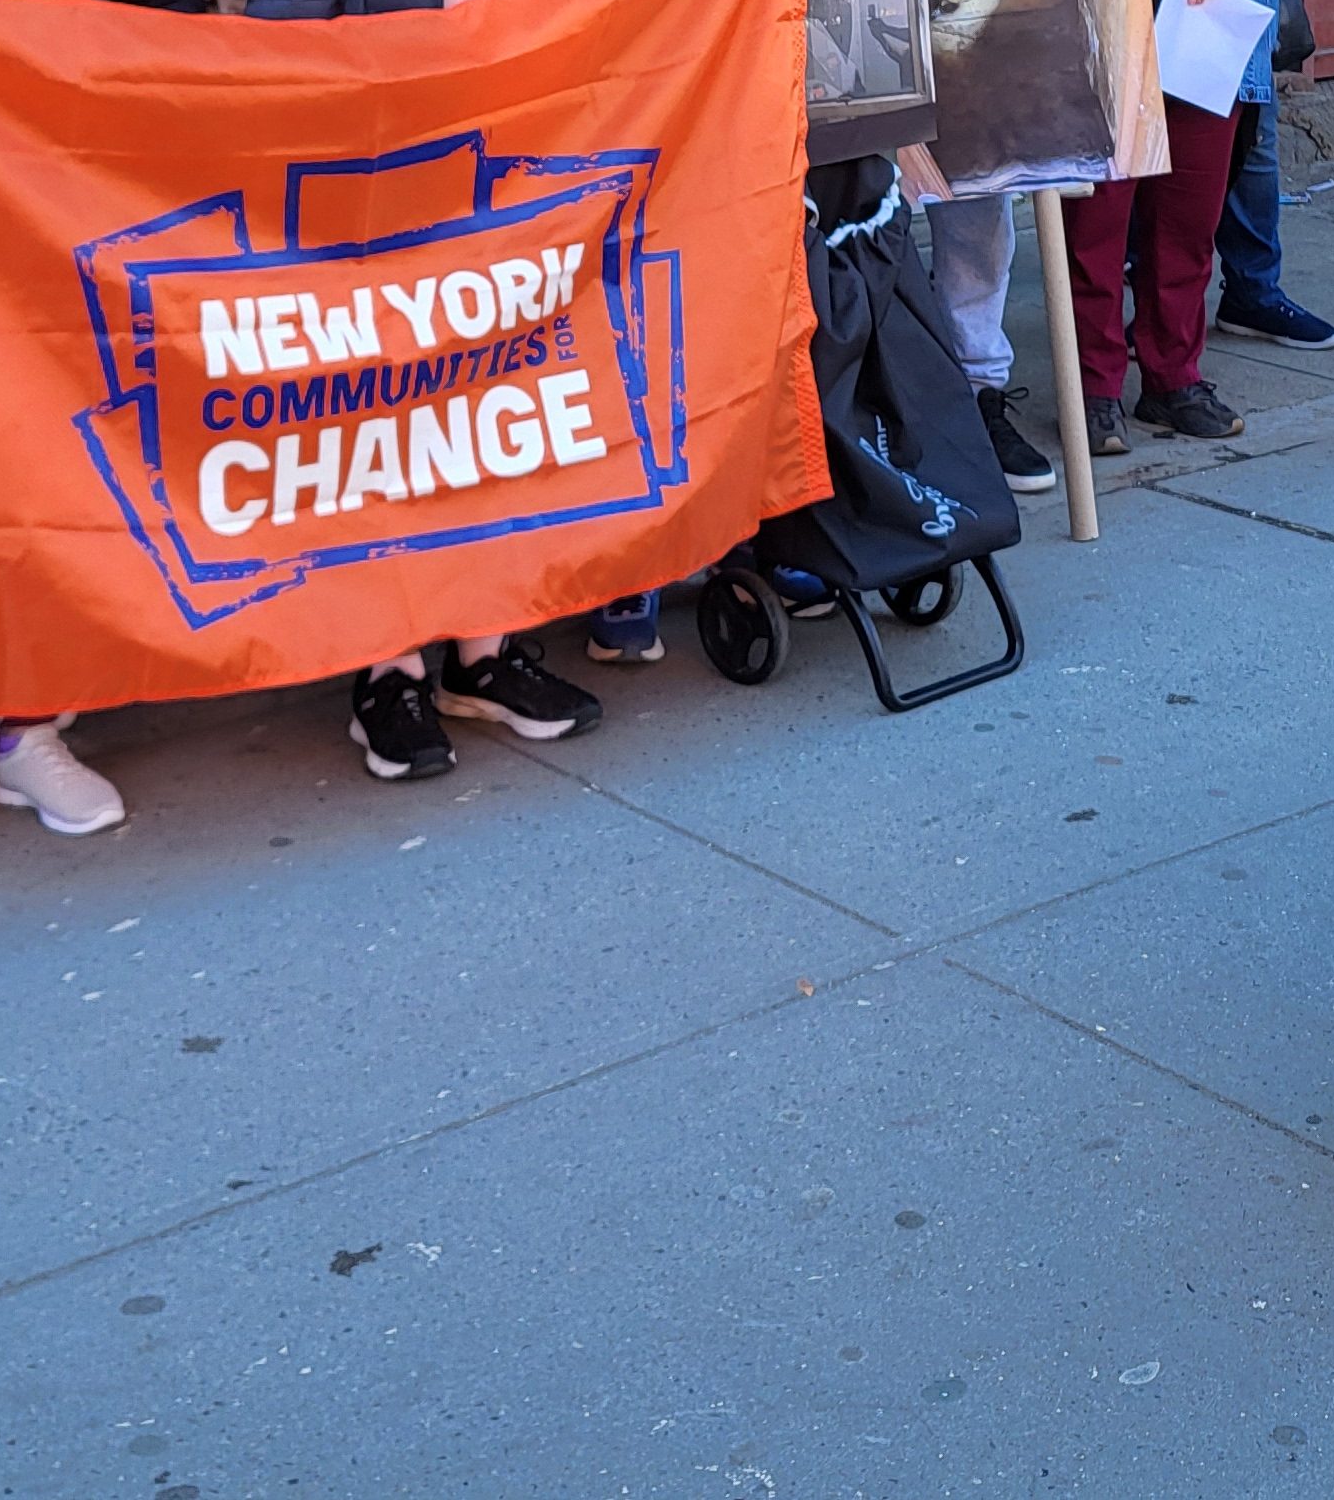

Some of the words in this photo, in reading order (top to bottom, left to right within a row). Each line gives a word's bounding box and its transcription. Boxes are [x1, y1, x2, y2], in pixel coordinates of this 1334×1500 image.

[199, 283, 384, 379] NEW
[379, 242, 586, 349] YORK
[202, 323, 549, 432] COMMUNITIES
[557, 313, 579, 362] FOR
[198, 369, 607, 536] CHANGE
